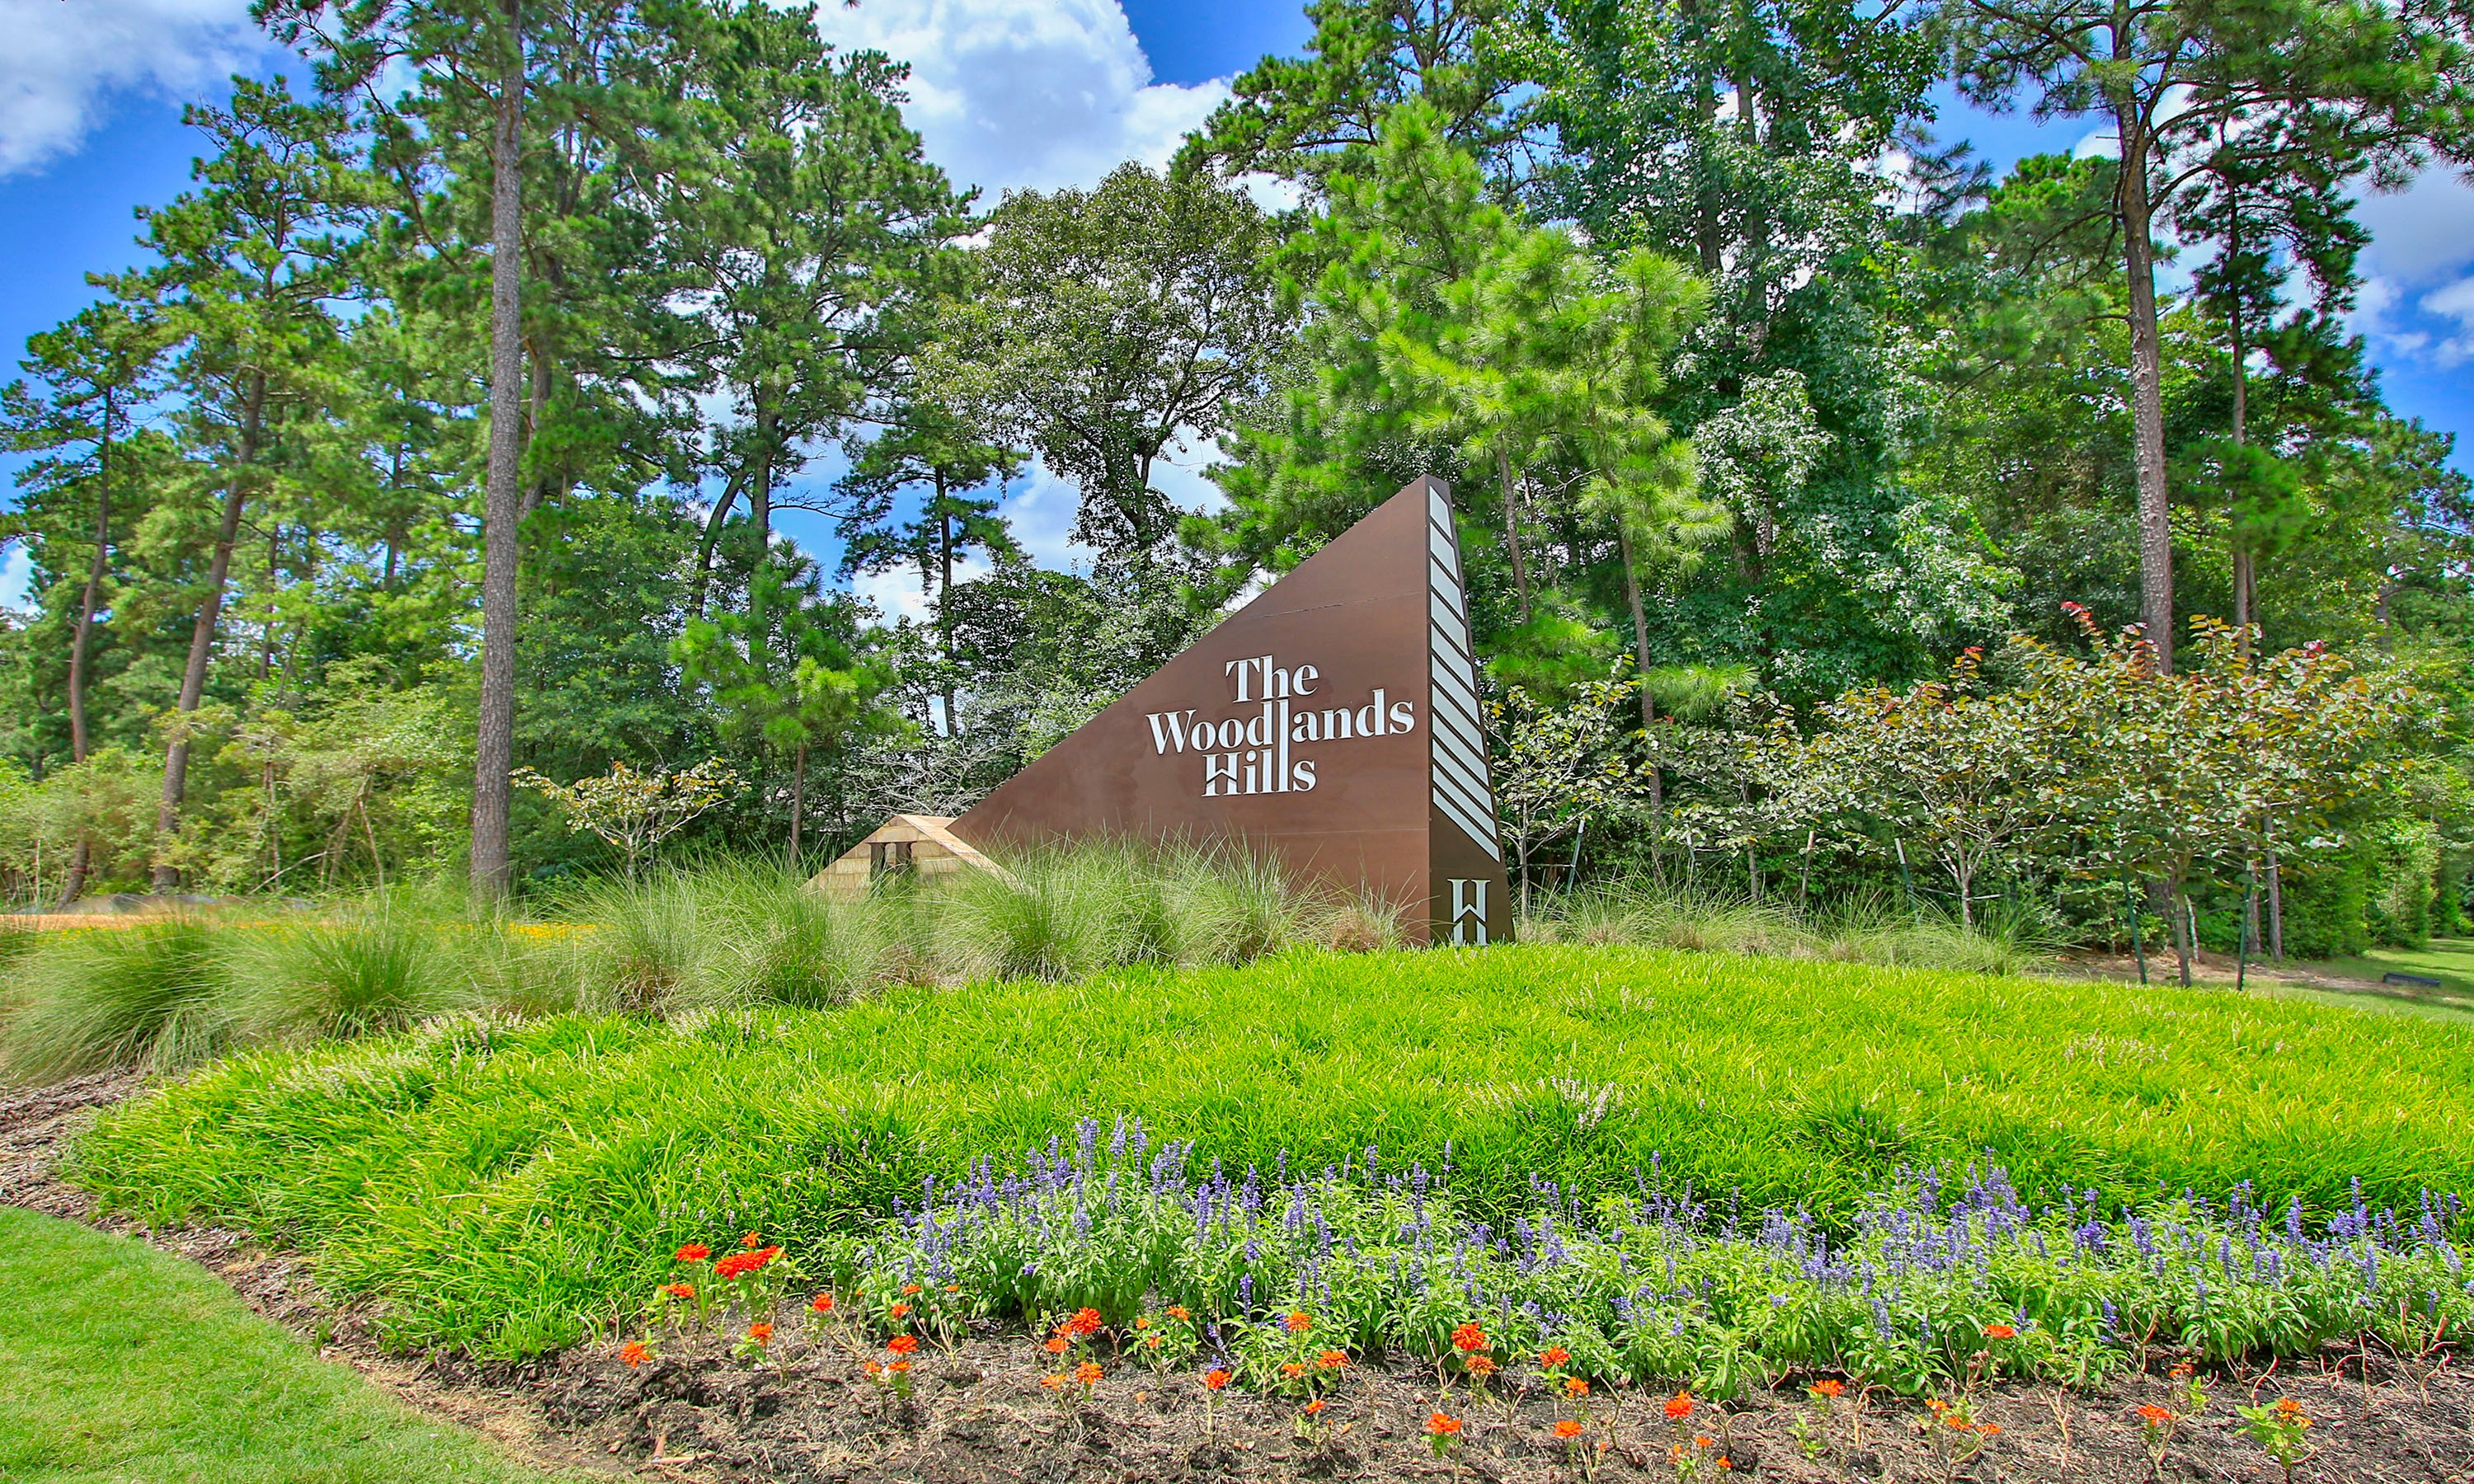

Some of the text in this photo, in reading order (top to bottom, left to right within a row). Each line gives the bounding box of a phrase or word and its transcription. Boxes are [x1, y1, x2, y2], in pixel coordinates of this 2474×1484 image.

[1225, 655, 1319, 703] The
[1145, 688, 1415, 754] Woodlands
[1201, 748, 1317, 797] Hills
